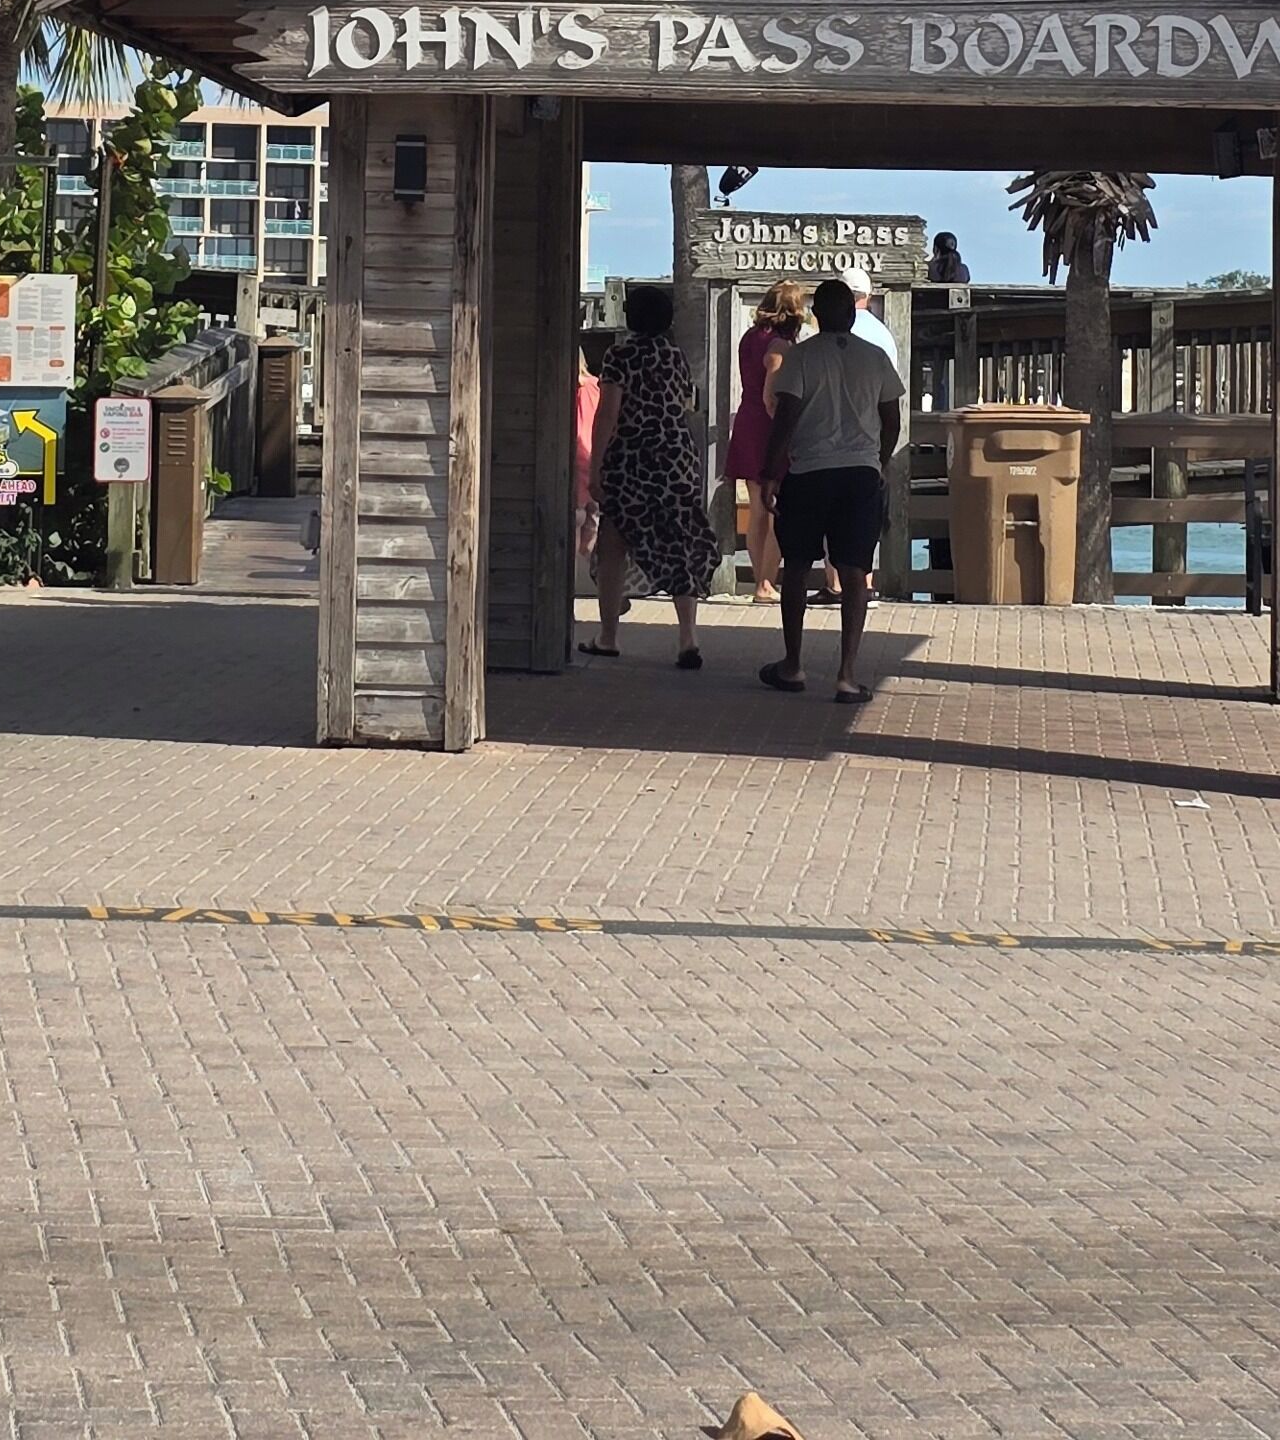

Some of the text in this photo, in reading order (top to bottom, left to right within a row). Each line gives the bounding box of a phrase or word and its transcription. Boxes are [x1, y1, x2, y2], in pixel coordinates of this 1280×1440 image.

[307, 4, 611, 75] JOHN'S
[649, 10, 868, 74] PASS
[714, 218, 909, 246] John's Pass
[736, 249, 883, 272] DIRECTORY
[0, 480, 36, 492] AHEAD
